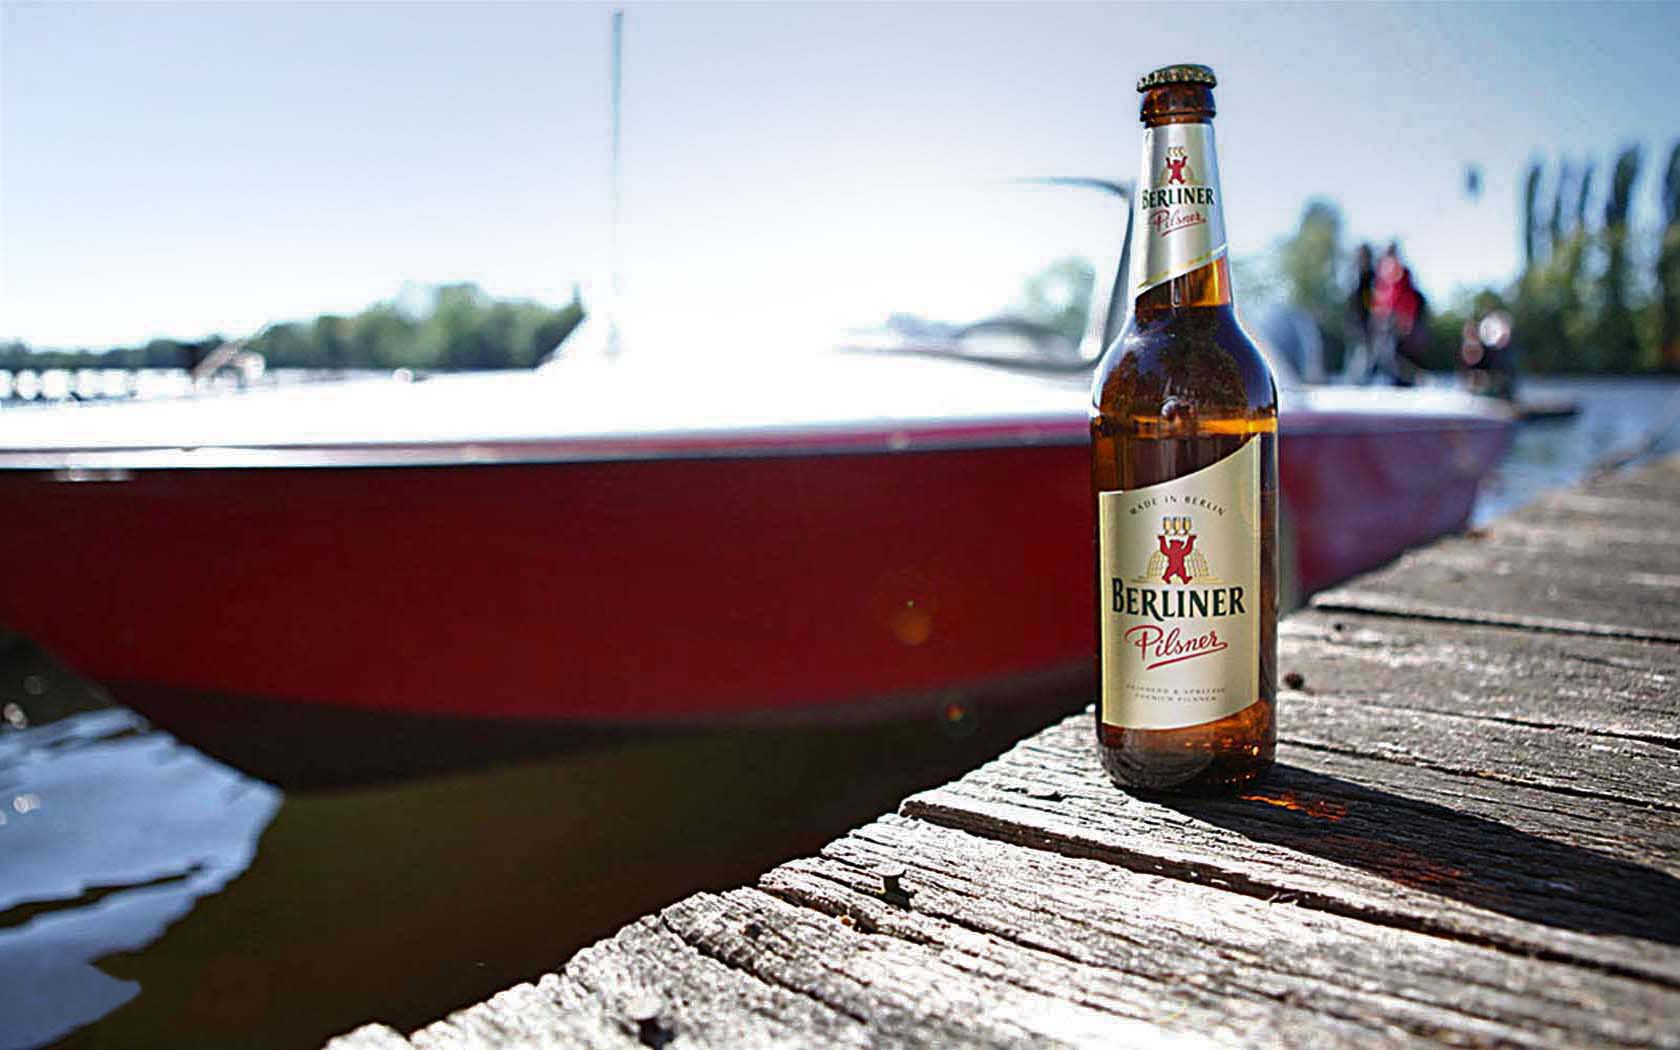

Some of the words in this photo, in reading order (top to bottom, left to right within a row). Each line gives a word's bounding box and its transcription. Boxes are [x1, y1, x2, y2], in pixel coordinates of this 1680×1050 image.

[1142, 187, 1214, 209] BERLINER
[1150, 209, 1206, 237] Pilsner
[1129, 498, 1156, 515] MADE
[1164, 495, 1177, 503] IN
[1184, 495, 1225, 516] BERLIN
[1112, 577, 1246, 621] BERLINER
[1124, 624, 1228, 670] Pilsner
